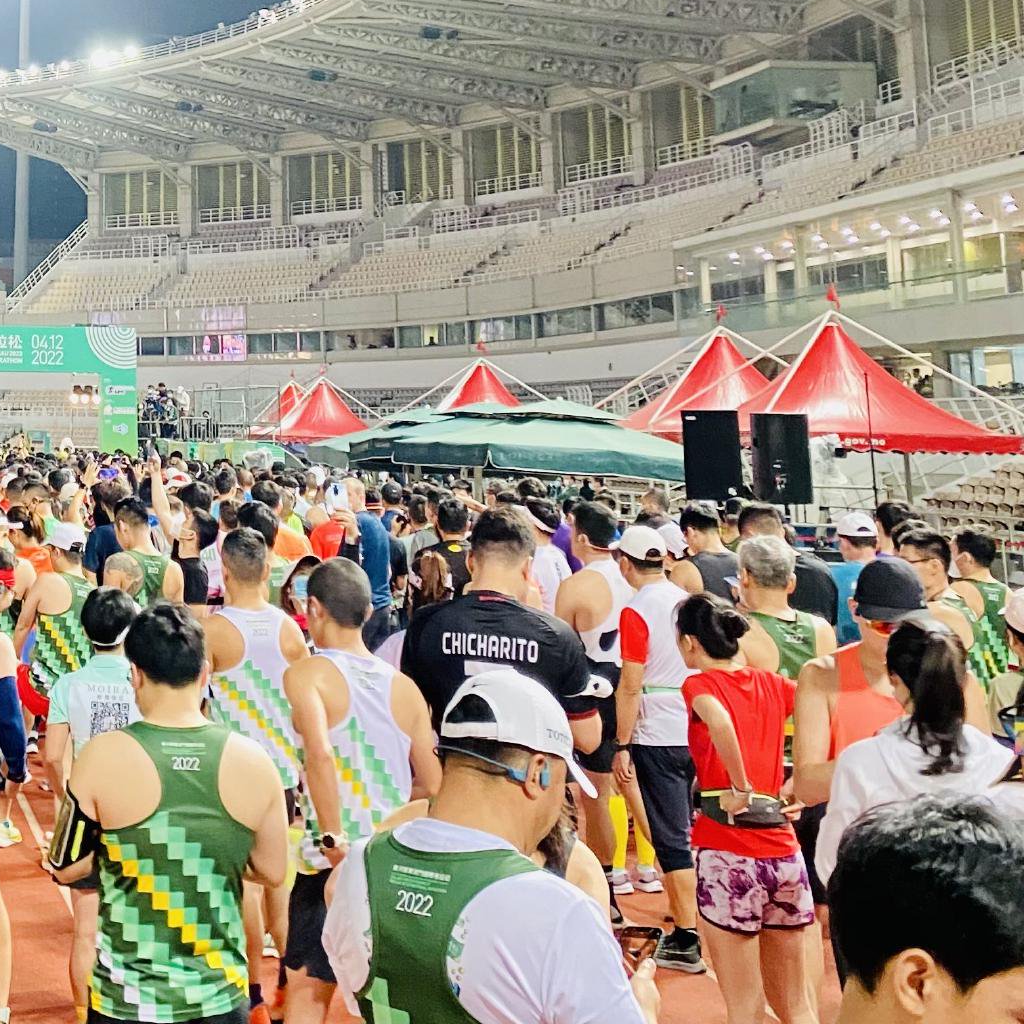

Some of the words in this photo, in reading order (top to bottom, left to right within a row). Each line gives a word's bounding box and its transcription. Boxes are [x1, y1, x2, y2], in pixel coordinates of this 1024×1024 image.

[31, 334, 64, 350] 04.12
[31, 350, 64, 366] 2022
[442, 632, 539, 663] CHICHARITO
[171, 756, 201, 772] 2022
[396, 890, 434, 917] 2022
